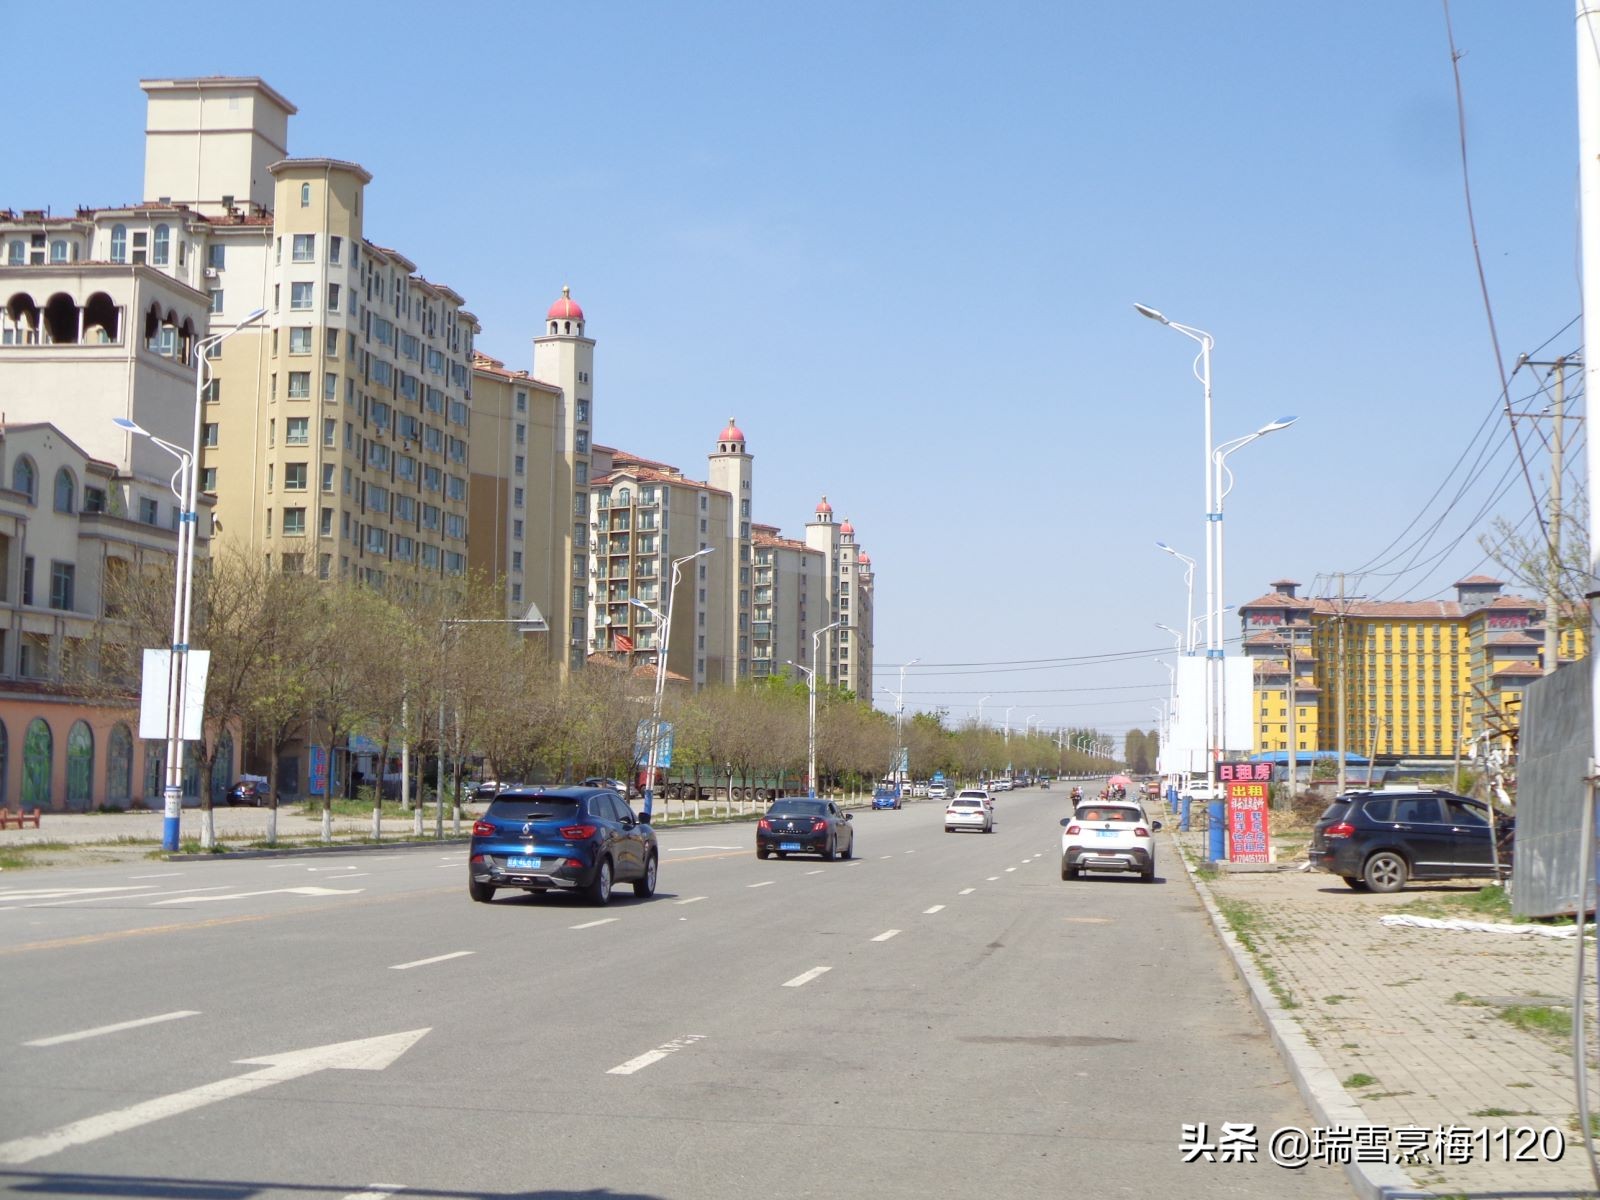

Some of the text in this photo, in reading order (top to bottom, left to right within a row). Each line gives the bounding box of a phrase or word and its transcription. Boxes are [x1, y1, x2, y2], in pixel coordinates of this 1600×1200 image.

[1220, 764, 1270, 781] 日租房
[1232, 785, 1263, 797] 出租
[1235, 842, 1265, 852] 日租房
